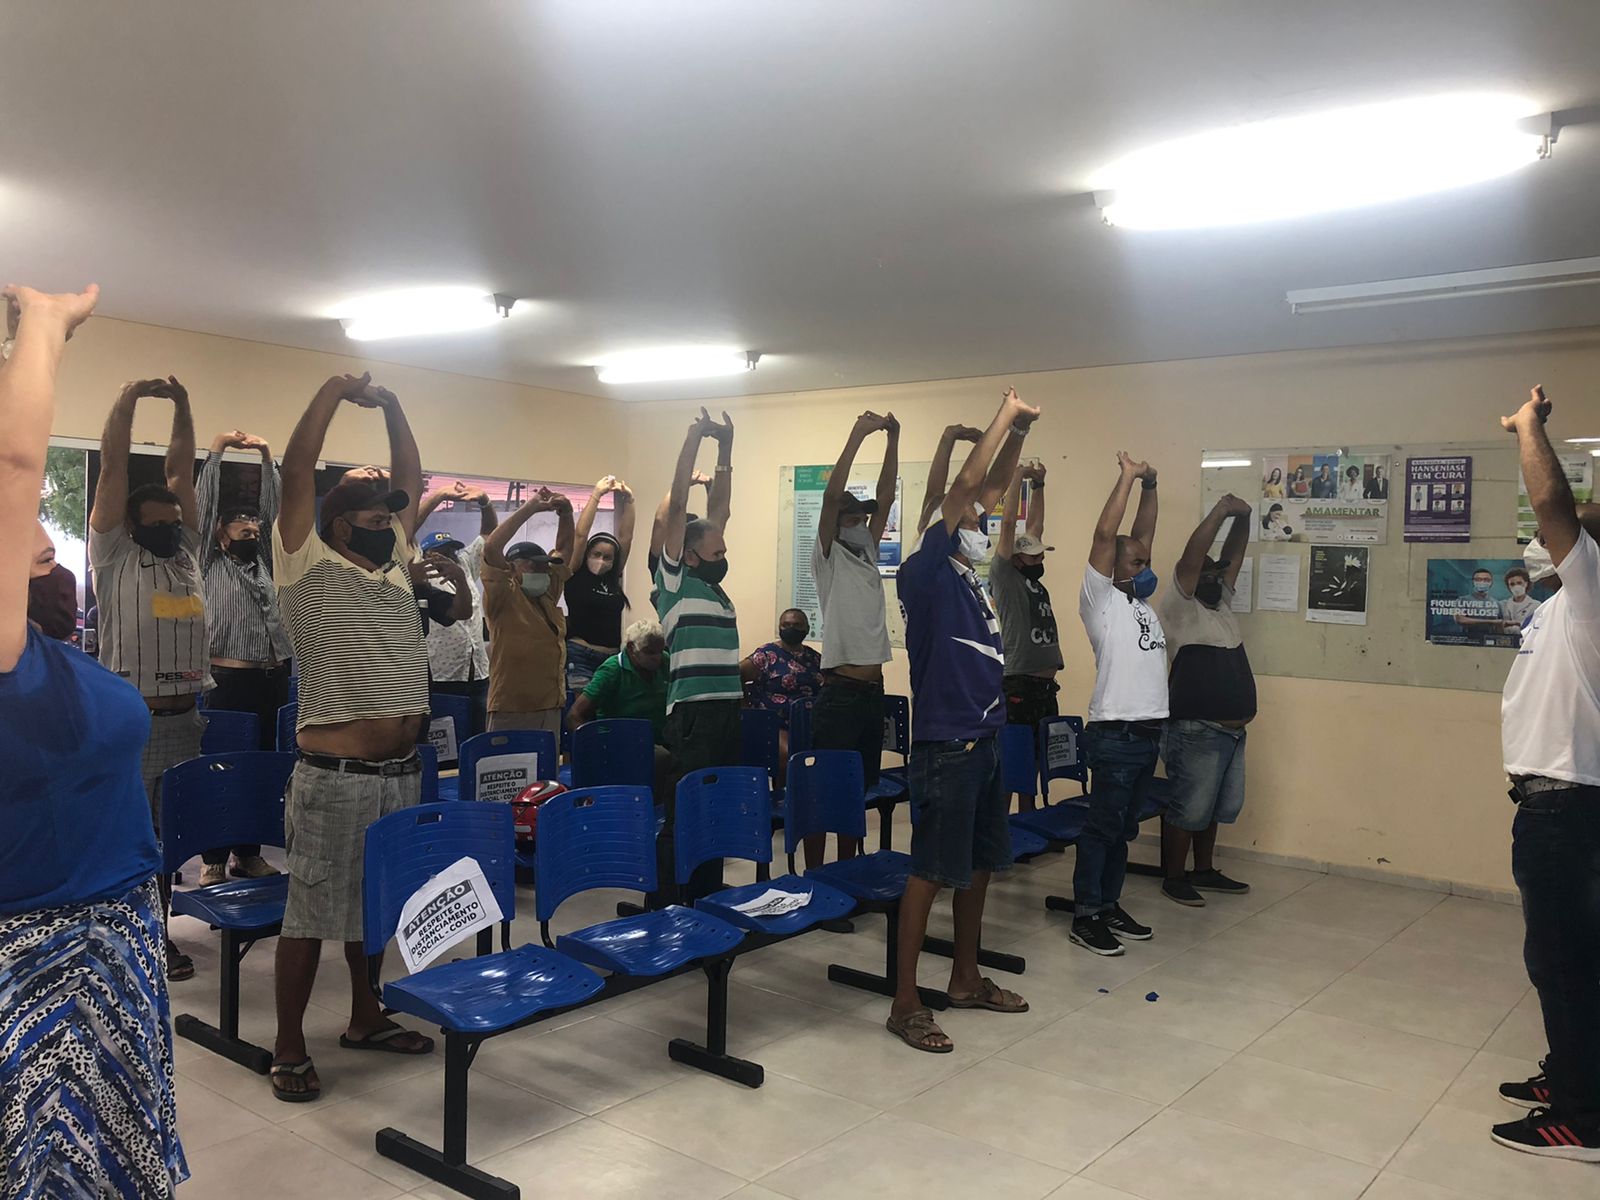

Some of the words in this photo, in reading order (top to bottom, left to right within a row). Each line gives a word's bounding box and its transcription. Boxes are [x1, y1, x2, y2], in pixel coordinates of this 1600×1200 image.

[1411, 472, 1431, 480] TEM
[1434, 471, 1466, 479] CURA!
[1305, 507, 1380, 517] AMAMENTAR
[1430, 599, 1456, 608] FIQUE
[1457, 600, 1484, 608] LIVRE
[1430, 607, 1499, 617] TUBERCULOSE
[482, 770, 523, 782] ATENÇÃO
[487, 782, 511, 790] RESPEITE
[407, 884, 466, 934] ATENÇÃO
[418, 908, 455, 938] RESPEITE
[454, 902, 461, 911] O
[410, 901, 479, 955] DISTANCIAMENTO
[416, 933, 445, 959] SOCIAL
[449, 912, 477, 933] COVID
